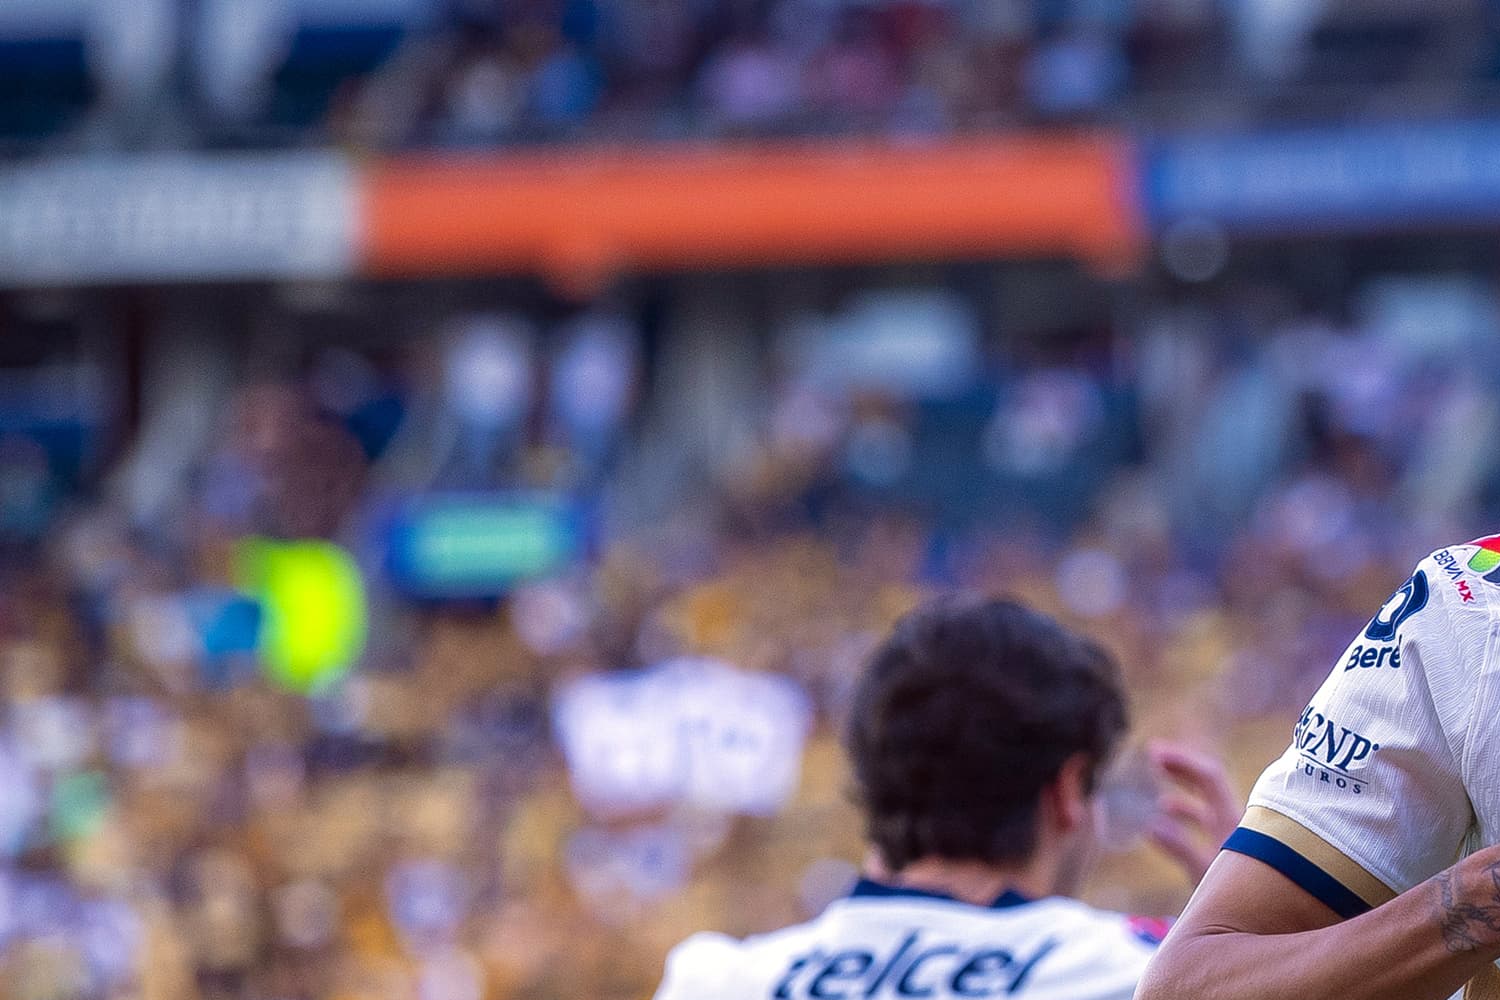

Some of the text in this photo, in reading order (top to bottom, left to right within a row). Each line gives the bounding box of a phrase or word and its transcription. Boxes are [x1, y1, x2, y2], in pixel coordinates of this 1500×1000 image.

[1433, 549, 1464, 581] BBVA
[1455, 580, 1475, 602] MX
[1300, 712, 1372, 773] GNP
[1296, 760, 1362, 794] UROS
